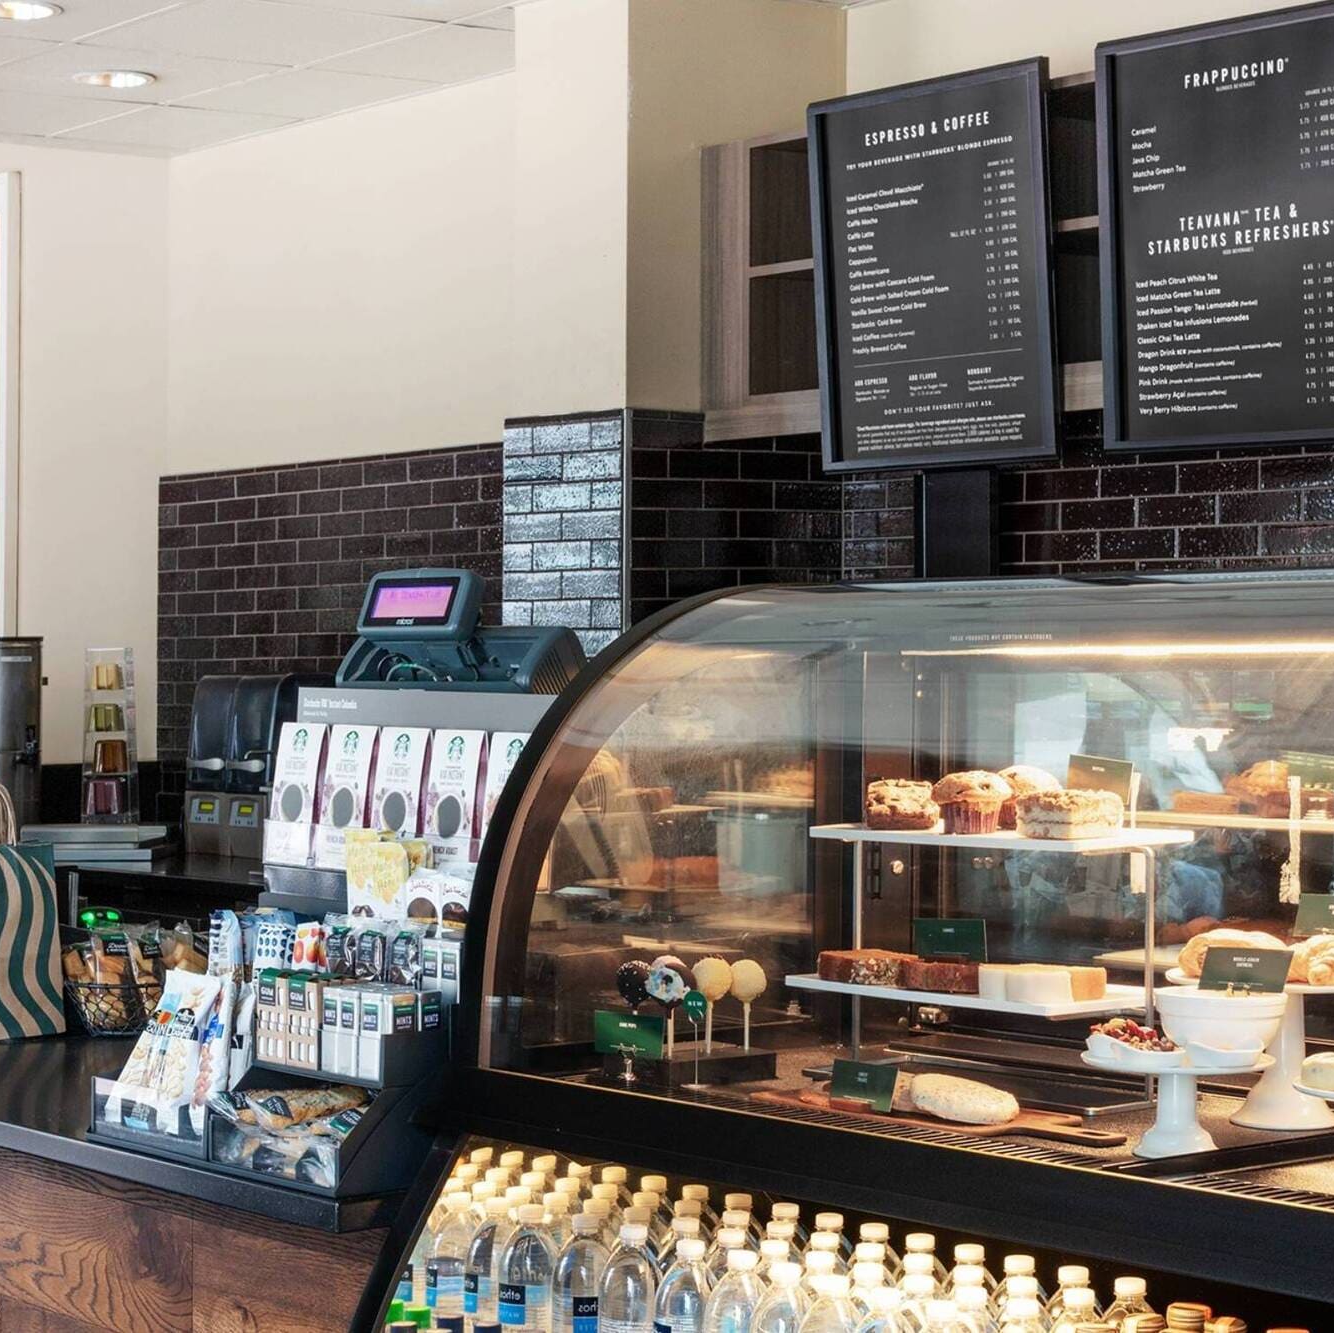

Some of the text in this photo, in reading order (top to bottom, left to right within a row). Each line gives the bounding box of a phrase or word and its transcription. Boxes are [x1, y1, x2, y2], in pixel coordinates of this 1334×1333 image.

[865, 111, 989, 146] ESPRESSO & COFFEE
[1148, 232, 1227, 255] STARBUCKS
[397, 1016, 411, 1025] MINTS
[425, 1014, 438, 1023] MINTS
